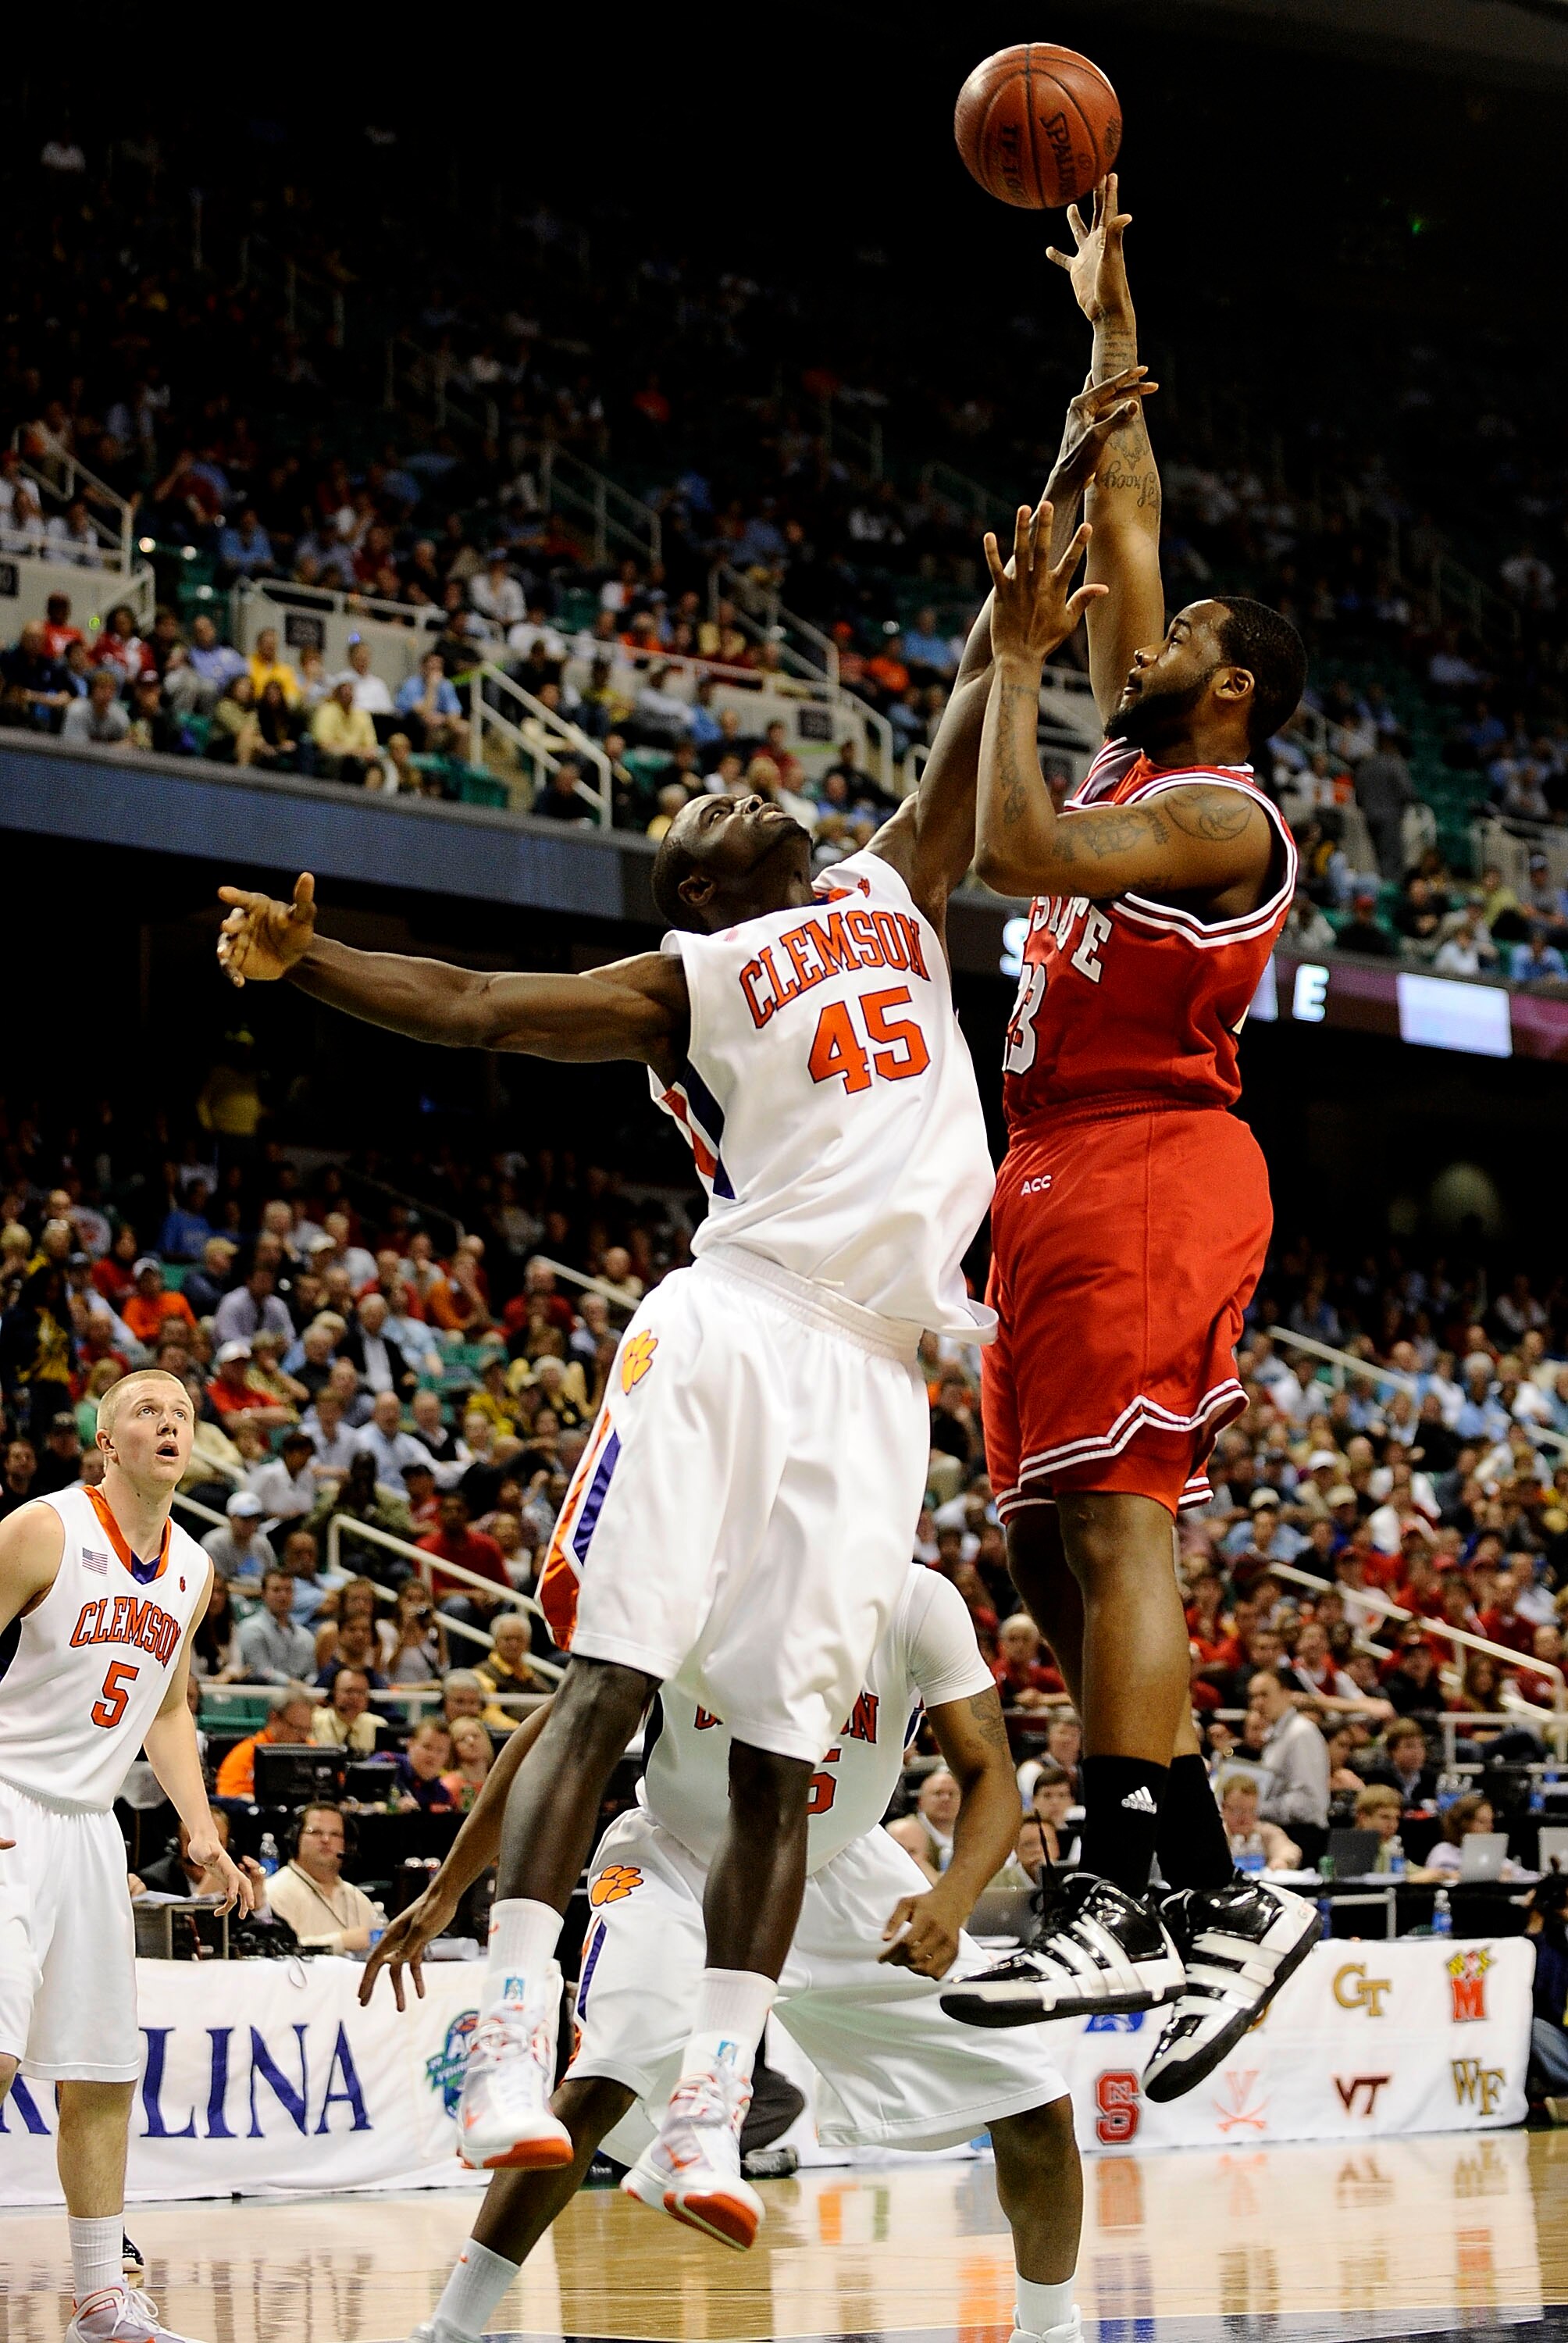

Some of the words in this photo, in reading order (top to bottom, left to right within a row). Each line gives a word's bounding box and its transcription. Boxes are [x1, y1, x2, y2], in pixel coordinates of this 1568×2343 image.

[739, 911, 932, 1029] CLEMSON
[1292, 963, 1330, 1022] E
[807, 986, 931, 1095] 45
[1021, 1175, 1052, 1196] ACC
[69, 1596, 183, 1668] CLEMSON
[91, 1660, 141, 1729] 5
[1334, 1963, 1391, 2017] GT
[1335, 2075, 1391, 2117] VT
[1451, 2057, 1506, 2117] WF
